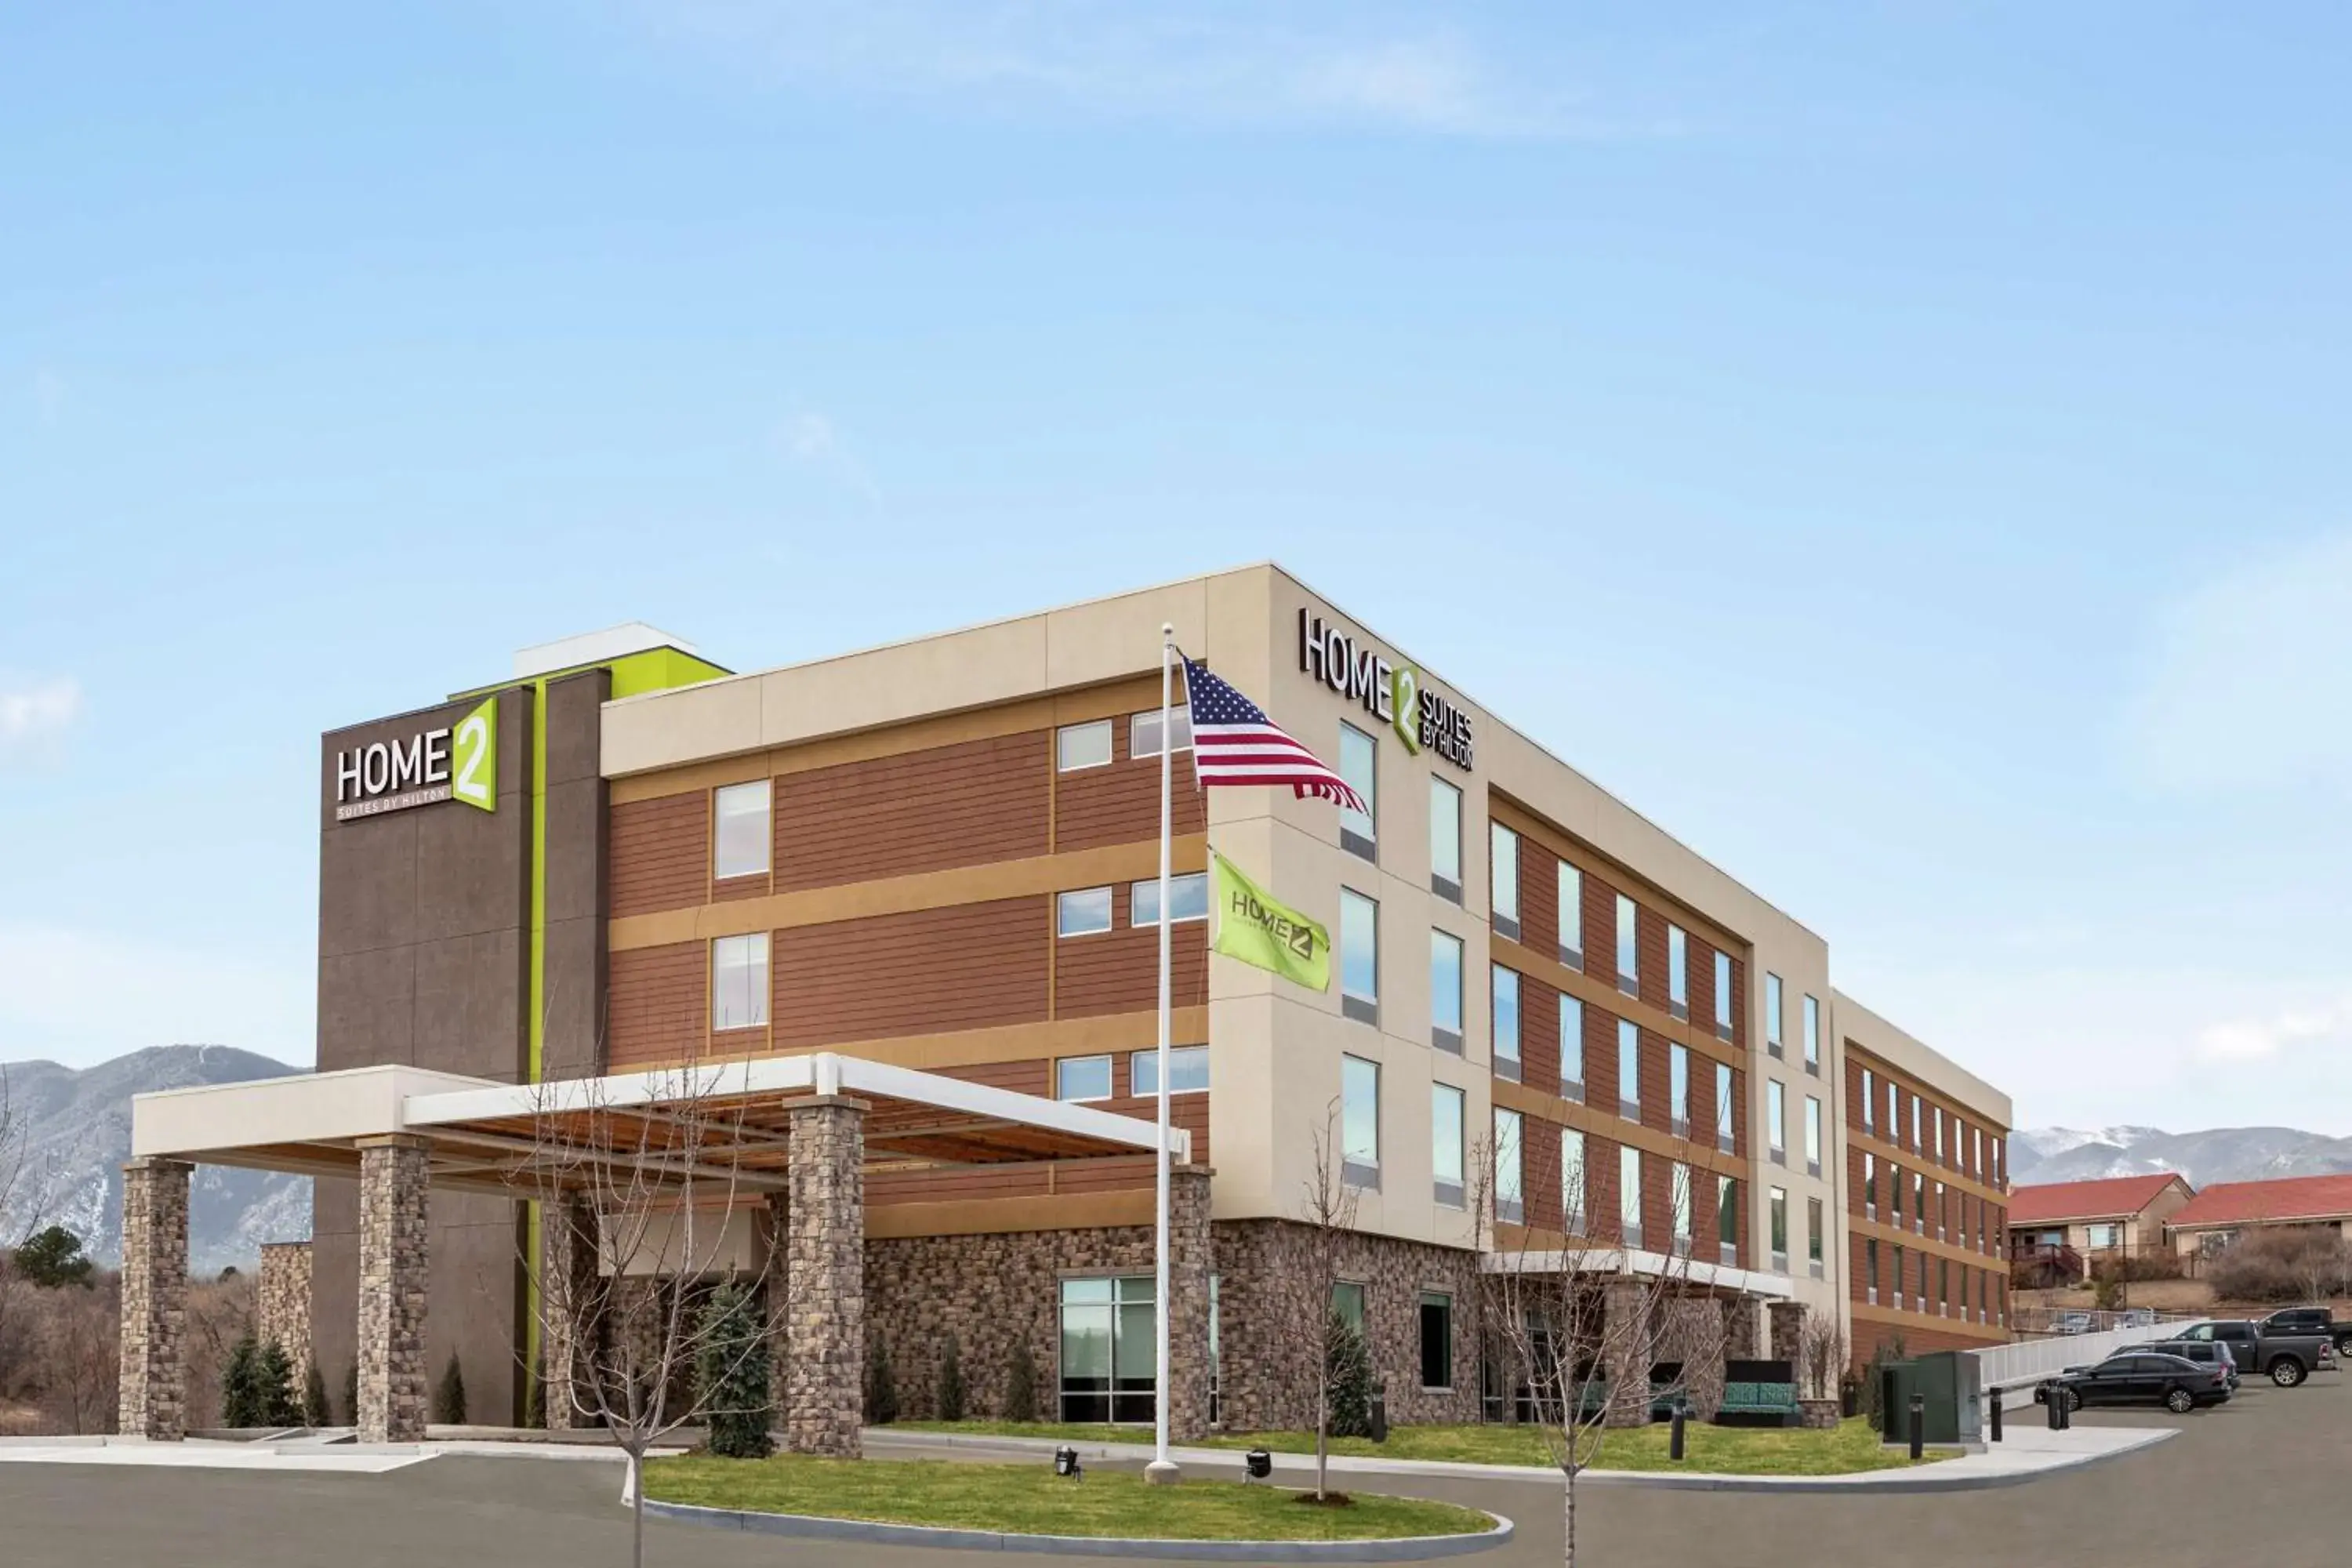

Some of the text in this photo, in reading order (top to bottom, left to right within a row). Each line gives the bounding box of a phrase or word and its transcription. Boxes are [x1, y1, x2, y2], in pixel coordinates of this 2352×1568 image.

[1421, 689, 1473, 744] SUITES
[1421, 722, 1473, 769] BY HILTON
[337, 802, 378, 817] SUITES
[401, 788, 445, 807] HILTON
